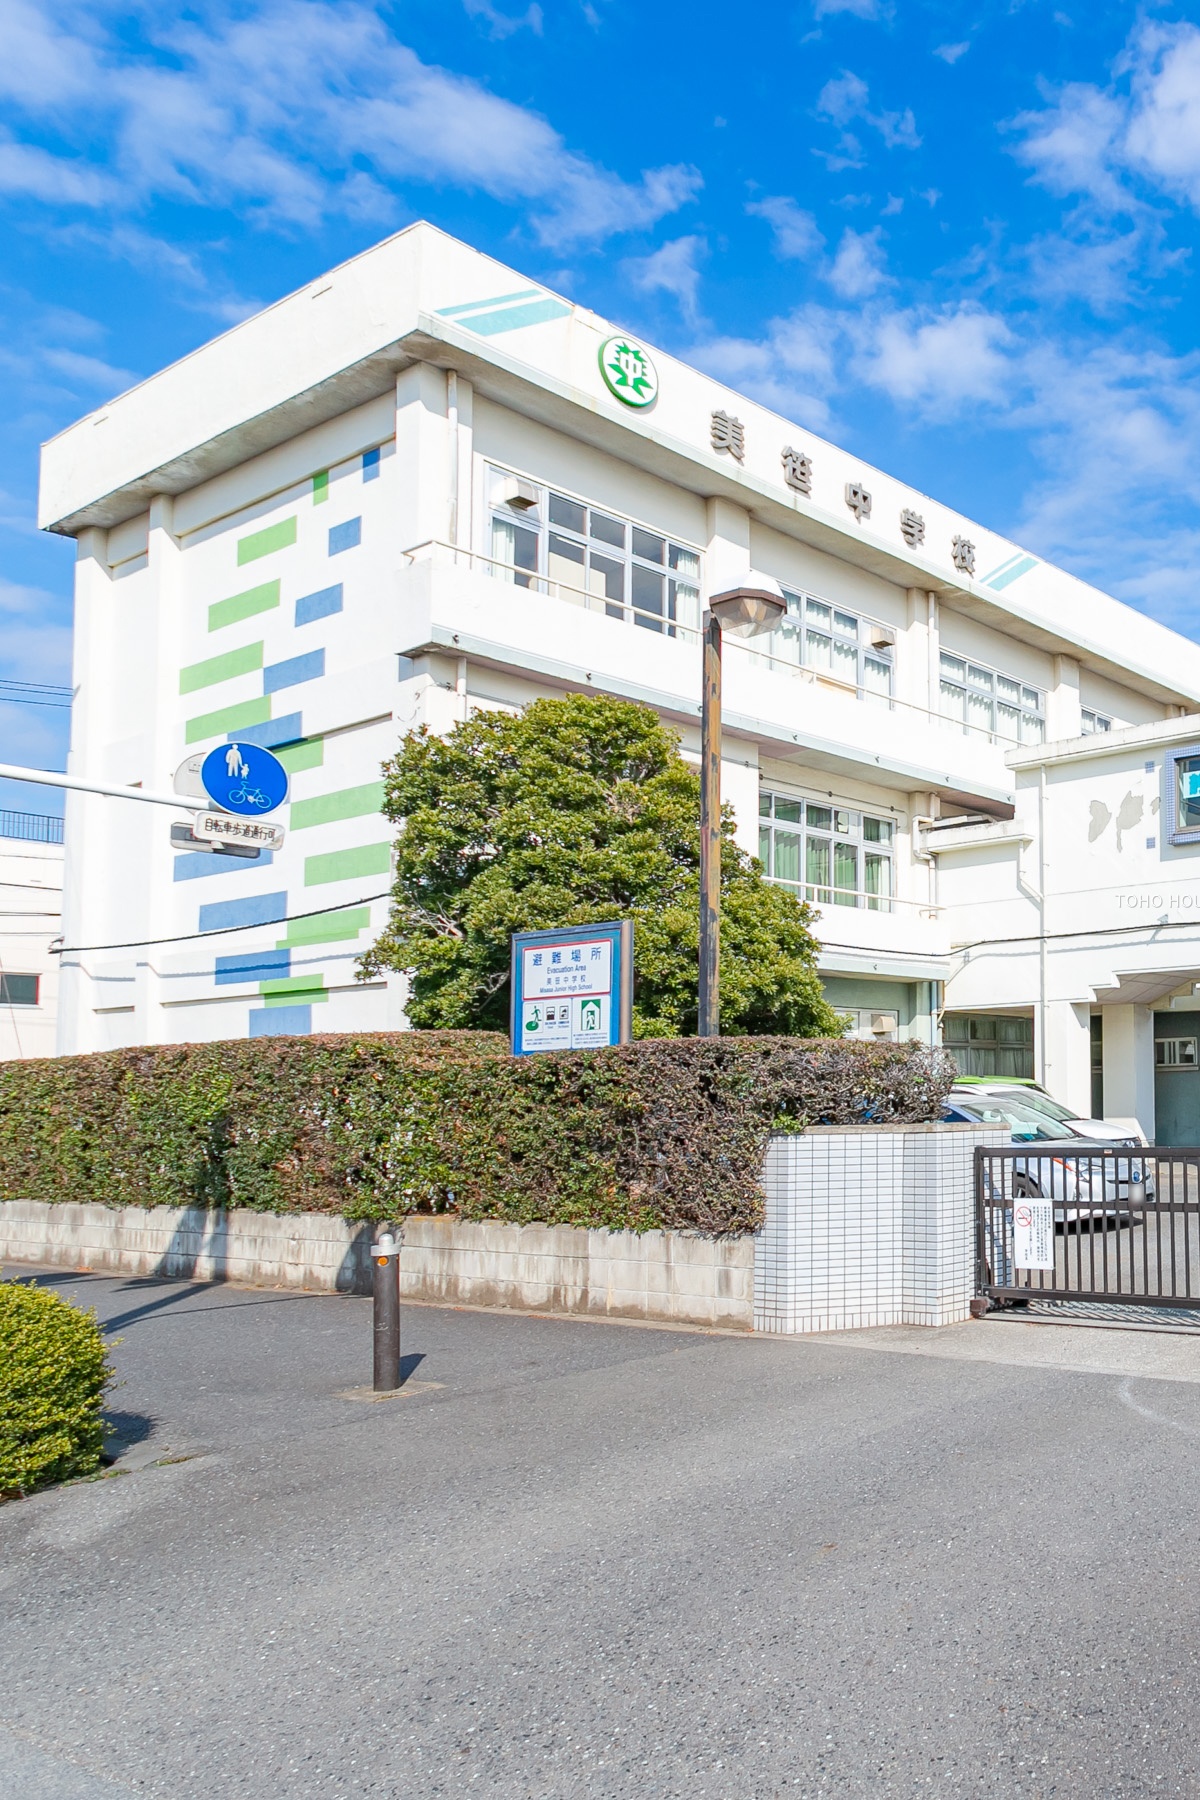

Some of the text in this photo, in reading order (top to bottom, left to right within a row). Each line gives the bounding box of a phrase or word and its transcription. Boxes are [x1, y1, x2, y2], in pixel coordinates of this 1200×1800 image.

[710, 409, 975, 574] 美笹中学校
[204, 817, 276, 842] 自転車歩道通行可
[533, 947, 601, 966] 避難場所
[547, 964, 587, 975] Evacuation Area
